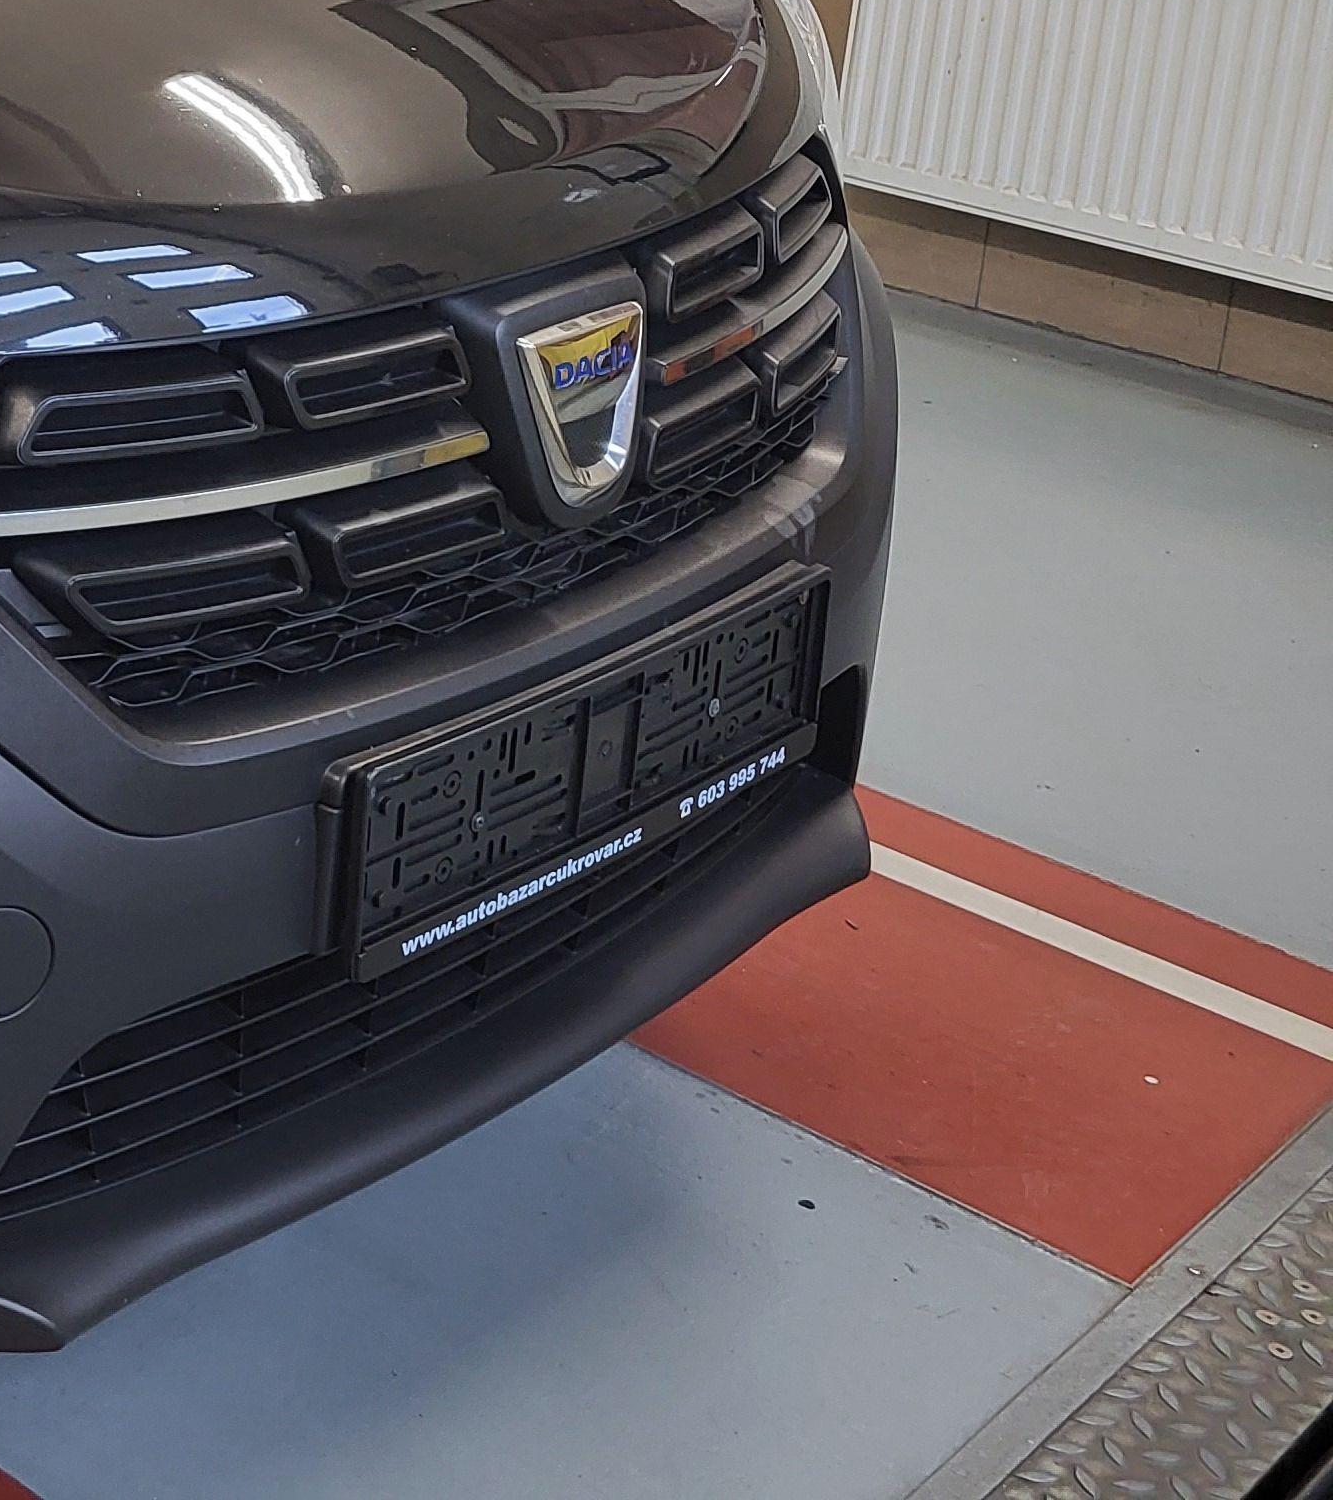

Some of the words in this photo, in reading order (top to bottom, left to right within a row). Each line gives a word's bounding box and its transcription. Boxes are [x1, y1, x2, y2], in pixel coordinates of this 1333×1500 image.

[554, 342, 633, 389] DACIA
[400, 826, 644, 957] www.autobazarcukrovar.cz
[697, 779, 726, 809] 603
[728, 762, 757, 792] 995
[759, 746, 786, 775] 744
